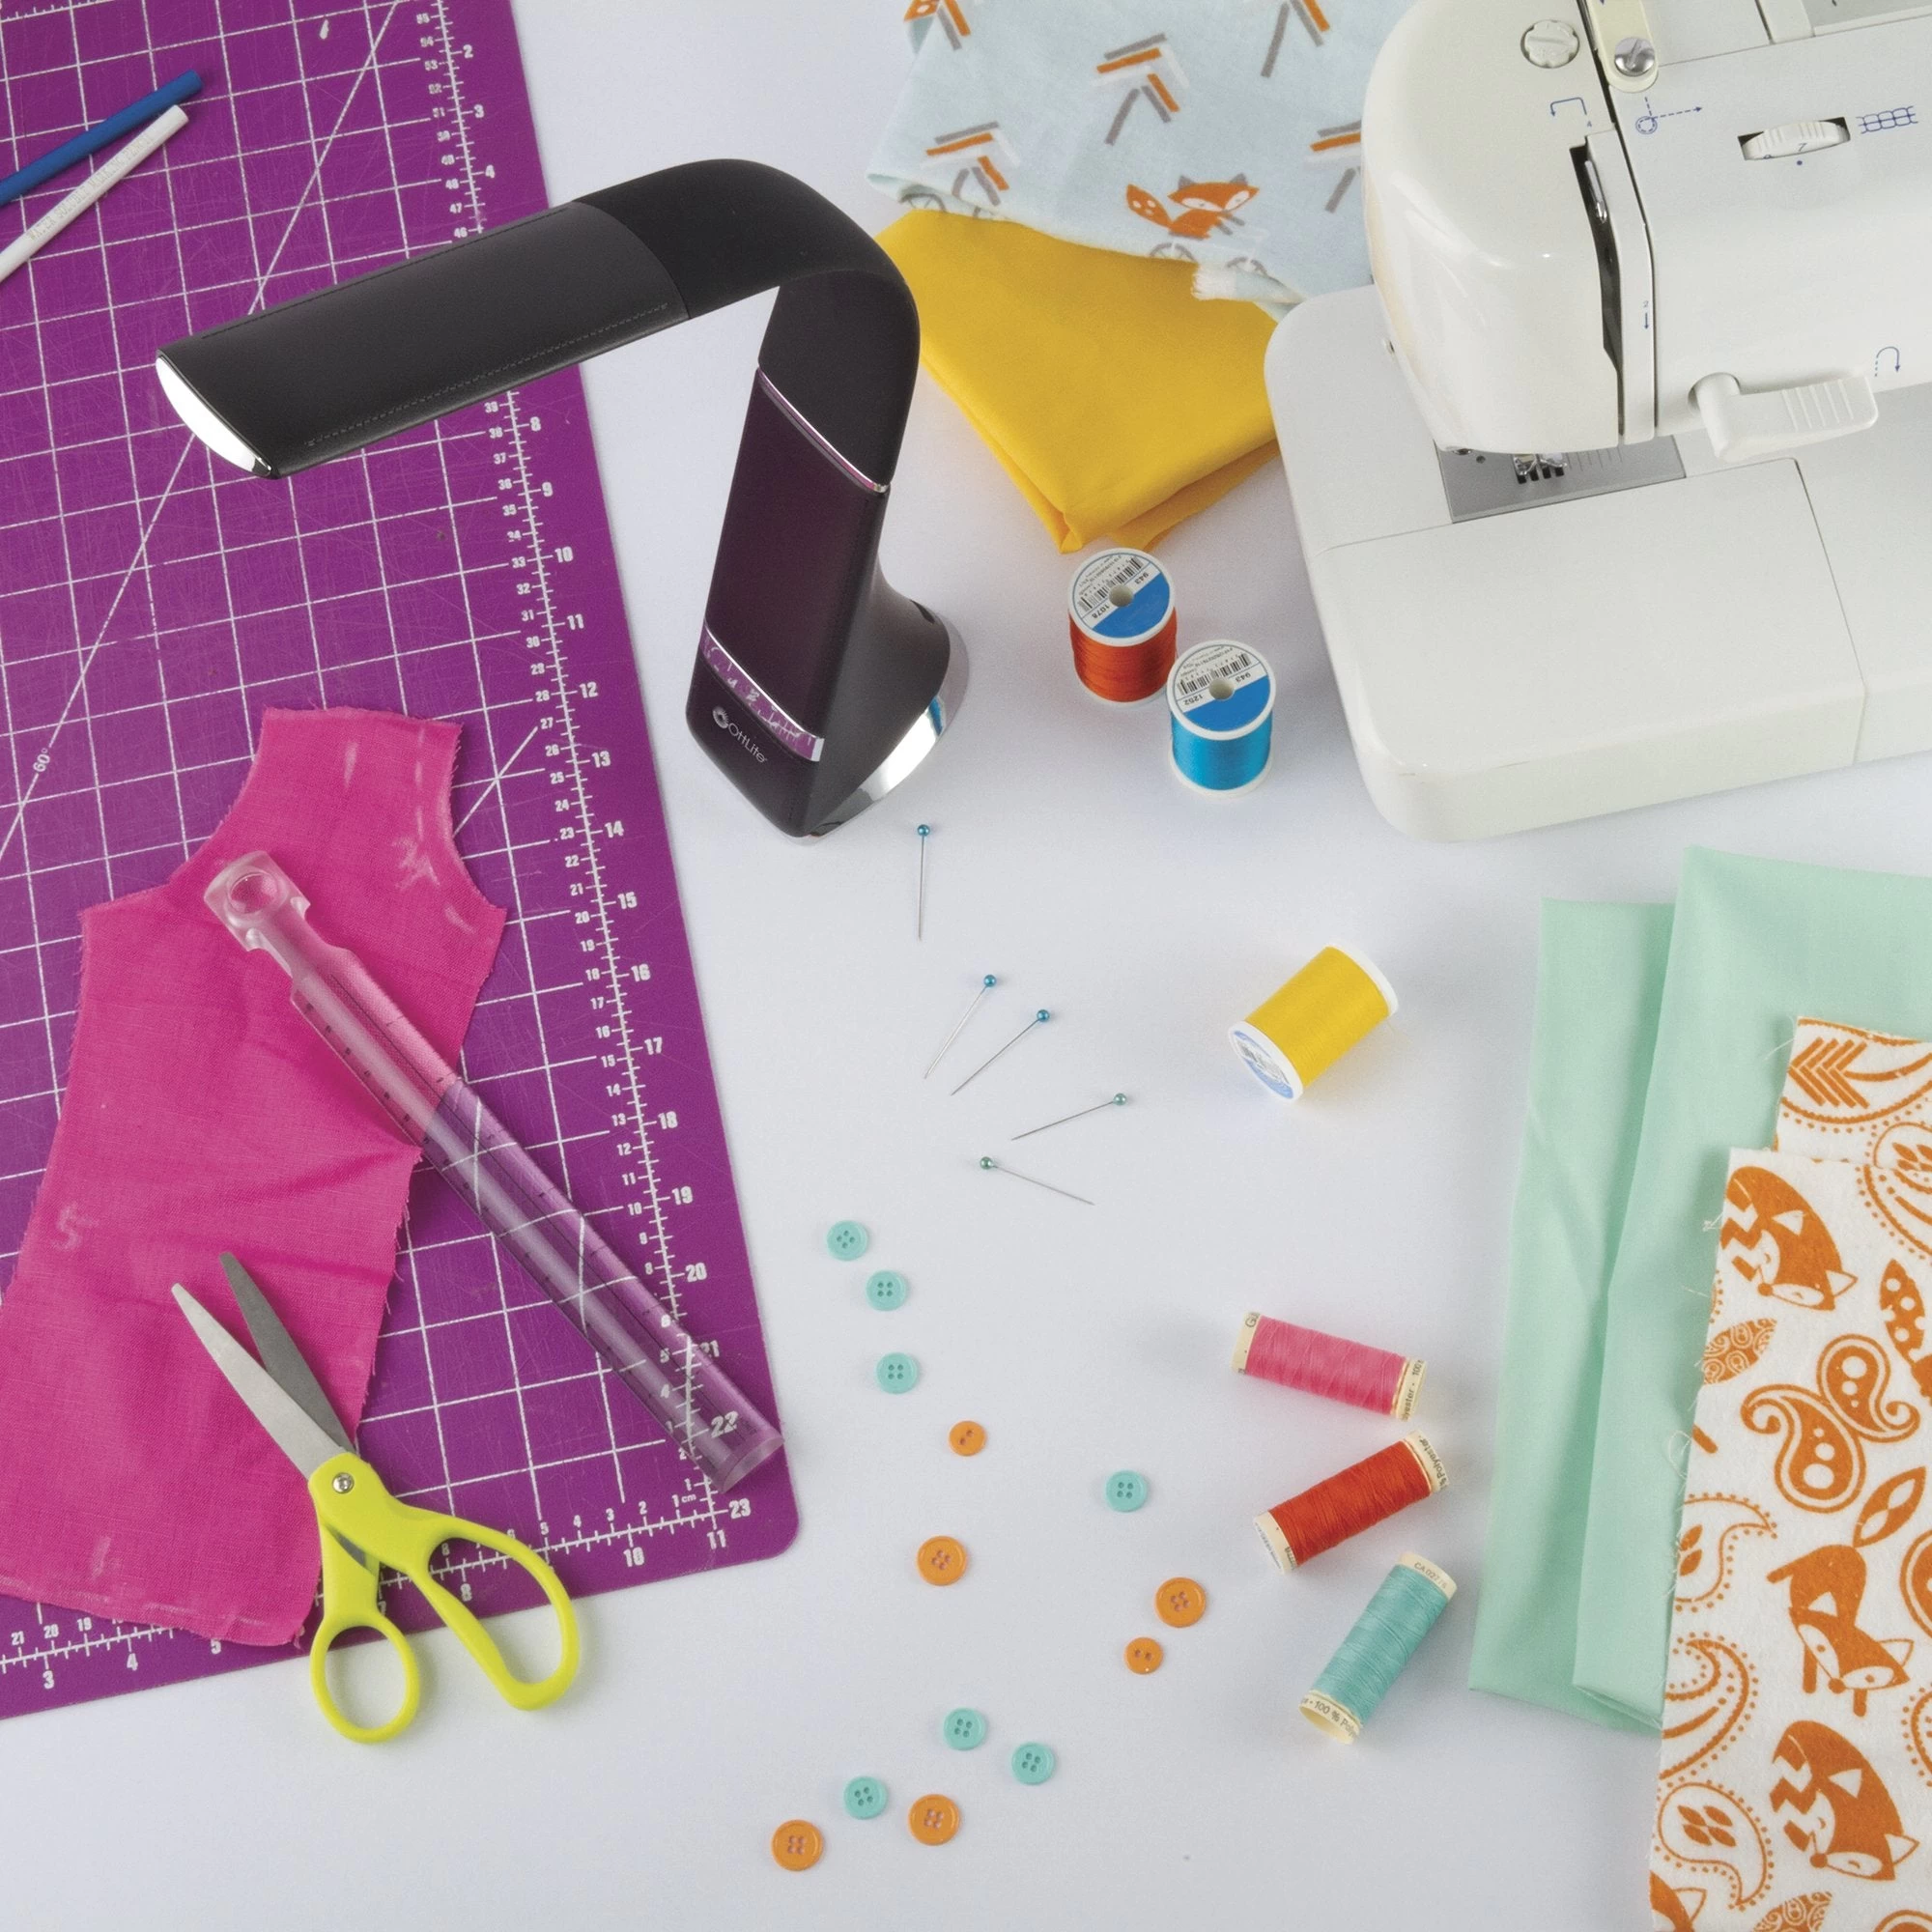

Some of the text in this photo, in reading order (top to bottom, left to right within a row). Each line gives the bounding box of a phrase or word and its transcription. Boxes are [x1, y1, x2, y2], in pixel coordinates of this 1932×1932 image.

[463, 44, 473, 58] 2
[474, 104, 484, 118] 3
[1797, 142, 1807, 153] 7
[485, 165, 495, 178] 4
[485, 401, 498, 412] 39
[530, 416, 541, 431] 8
[489, 427, 503, 439] 38
[494, 452, 506, 464] 37
[498, 478, 512, 490] 36
[542, 482, 553, 497] 9
[502, 504, 517, 516] 35
[507, 530, 522, 542] 34
[554, 547, 573, 562] 10
[512, 556, 526, 568] 33
[1134, 571, 1150, 585] 943
[517, 582, 530, 594] 32
[522, 610, 534, 621] 31
[567, 614, 583, 630] 11
[526, 636, 540, 648] 30
[530, 663, 545, 674] 29
[580, 682, 598, 698] 12
[1184, 671, 1252, 706] 943 1252
[536, 690, 550, 701] 28
[541, 717, 553, 729] 27
[545, 744, 559, 756] 26
[592, 751, 611, 767] 13
[550, 772, 564, 784] 25
[555, 799, 569, 811] 24
[560, 827, 574, 839] 23
[605, 821, 624, 838] 14
[565, 855, 580, 867] 22
[570, 883, 582, 895] 21
[618, 892, 637, 909] 15
[575, 911, 589, 923] 20
[581, 939, 595, 952] 19
[585, 968, 600, 980] 18
[631, 964, 650, 981] 16
[590, 997, 604, 1009] 17
[596, 1026, 611, 1038] 16
[644, 1037, 662, 1055] 17
[601, 1055, 615, 1067] 15
[607, 1084, 621, 1096] 14
[611, 1113, 626, 1126] 13
[658, 1111, 677, 1129] 18
[617, 1143, 632, 1155] 12
[622, 1173, 636, 1185] 11
[672, 1186, 693, 1205] 19
[628, 1202, 641, 1215] 10
[686, 1263, 707, 1282] 20
[660, 1348, 669, 1363] 5
[661, 1384, 669, 1399] 4
[711, 1411, 739, 1438] 22
[1419, 1438, 1447, 1479] Polyester
[685, 1478, 692, 1491] 1
[672, 1494, 696, 1507] 1 cm
[606, 1508, 614, 1521] 3
[639, 1501, 647, 1515] 2
[729, 1498, 751, 1519] 23
[574, 1515, 582, 1527] 4
[540, 1522, 549, 1535] 5
[707, 1529, 725, 1549] 11
[623, 1547, 644, 1567] 10
[461, 1583, 471, 1601] 8
[43, 1624, 59, 1638] 20
[77, 1617, 92, 1632] 19
[12, 1631, 24, 1645] 21
[127, 1653, 138, 1670] 4
[43, 1670, 54, 1689] 3
[1314, 1700, 1331, 1715] 100
[1330, 1709, 1341, 1722] %
